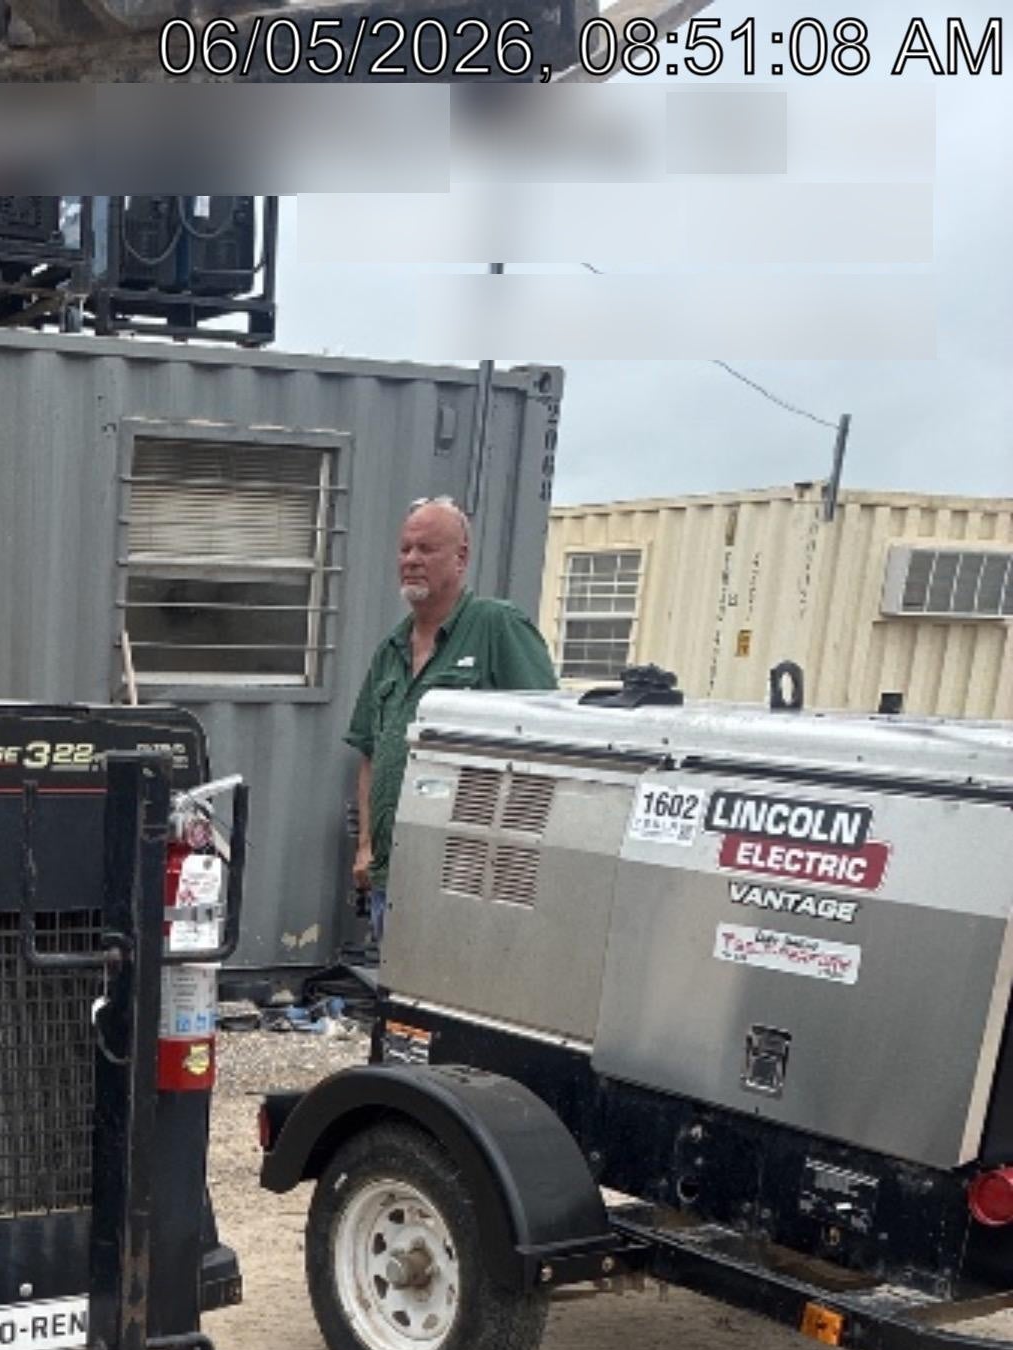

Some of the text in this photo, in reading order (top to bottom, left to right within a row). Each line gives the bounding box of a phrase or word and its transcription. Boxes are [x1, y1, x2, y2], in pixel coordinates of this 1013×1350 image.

[23, 741, 94, 769] 322
[642, 791, 699, 820] 1602
[711, 797, 861, 844] LINCOLN
[736, 842, 868, 882] ELECTRIC
[729, 882, 858, 923] VANTAGE
